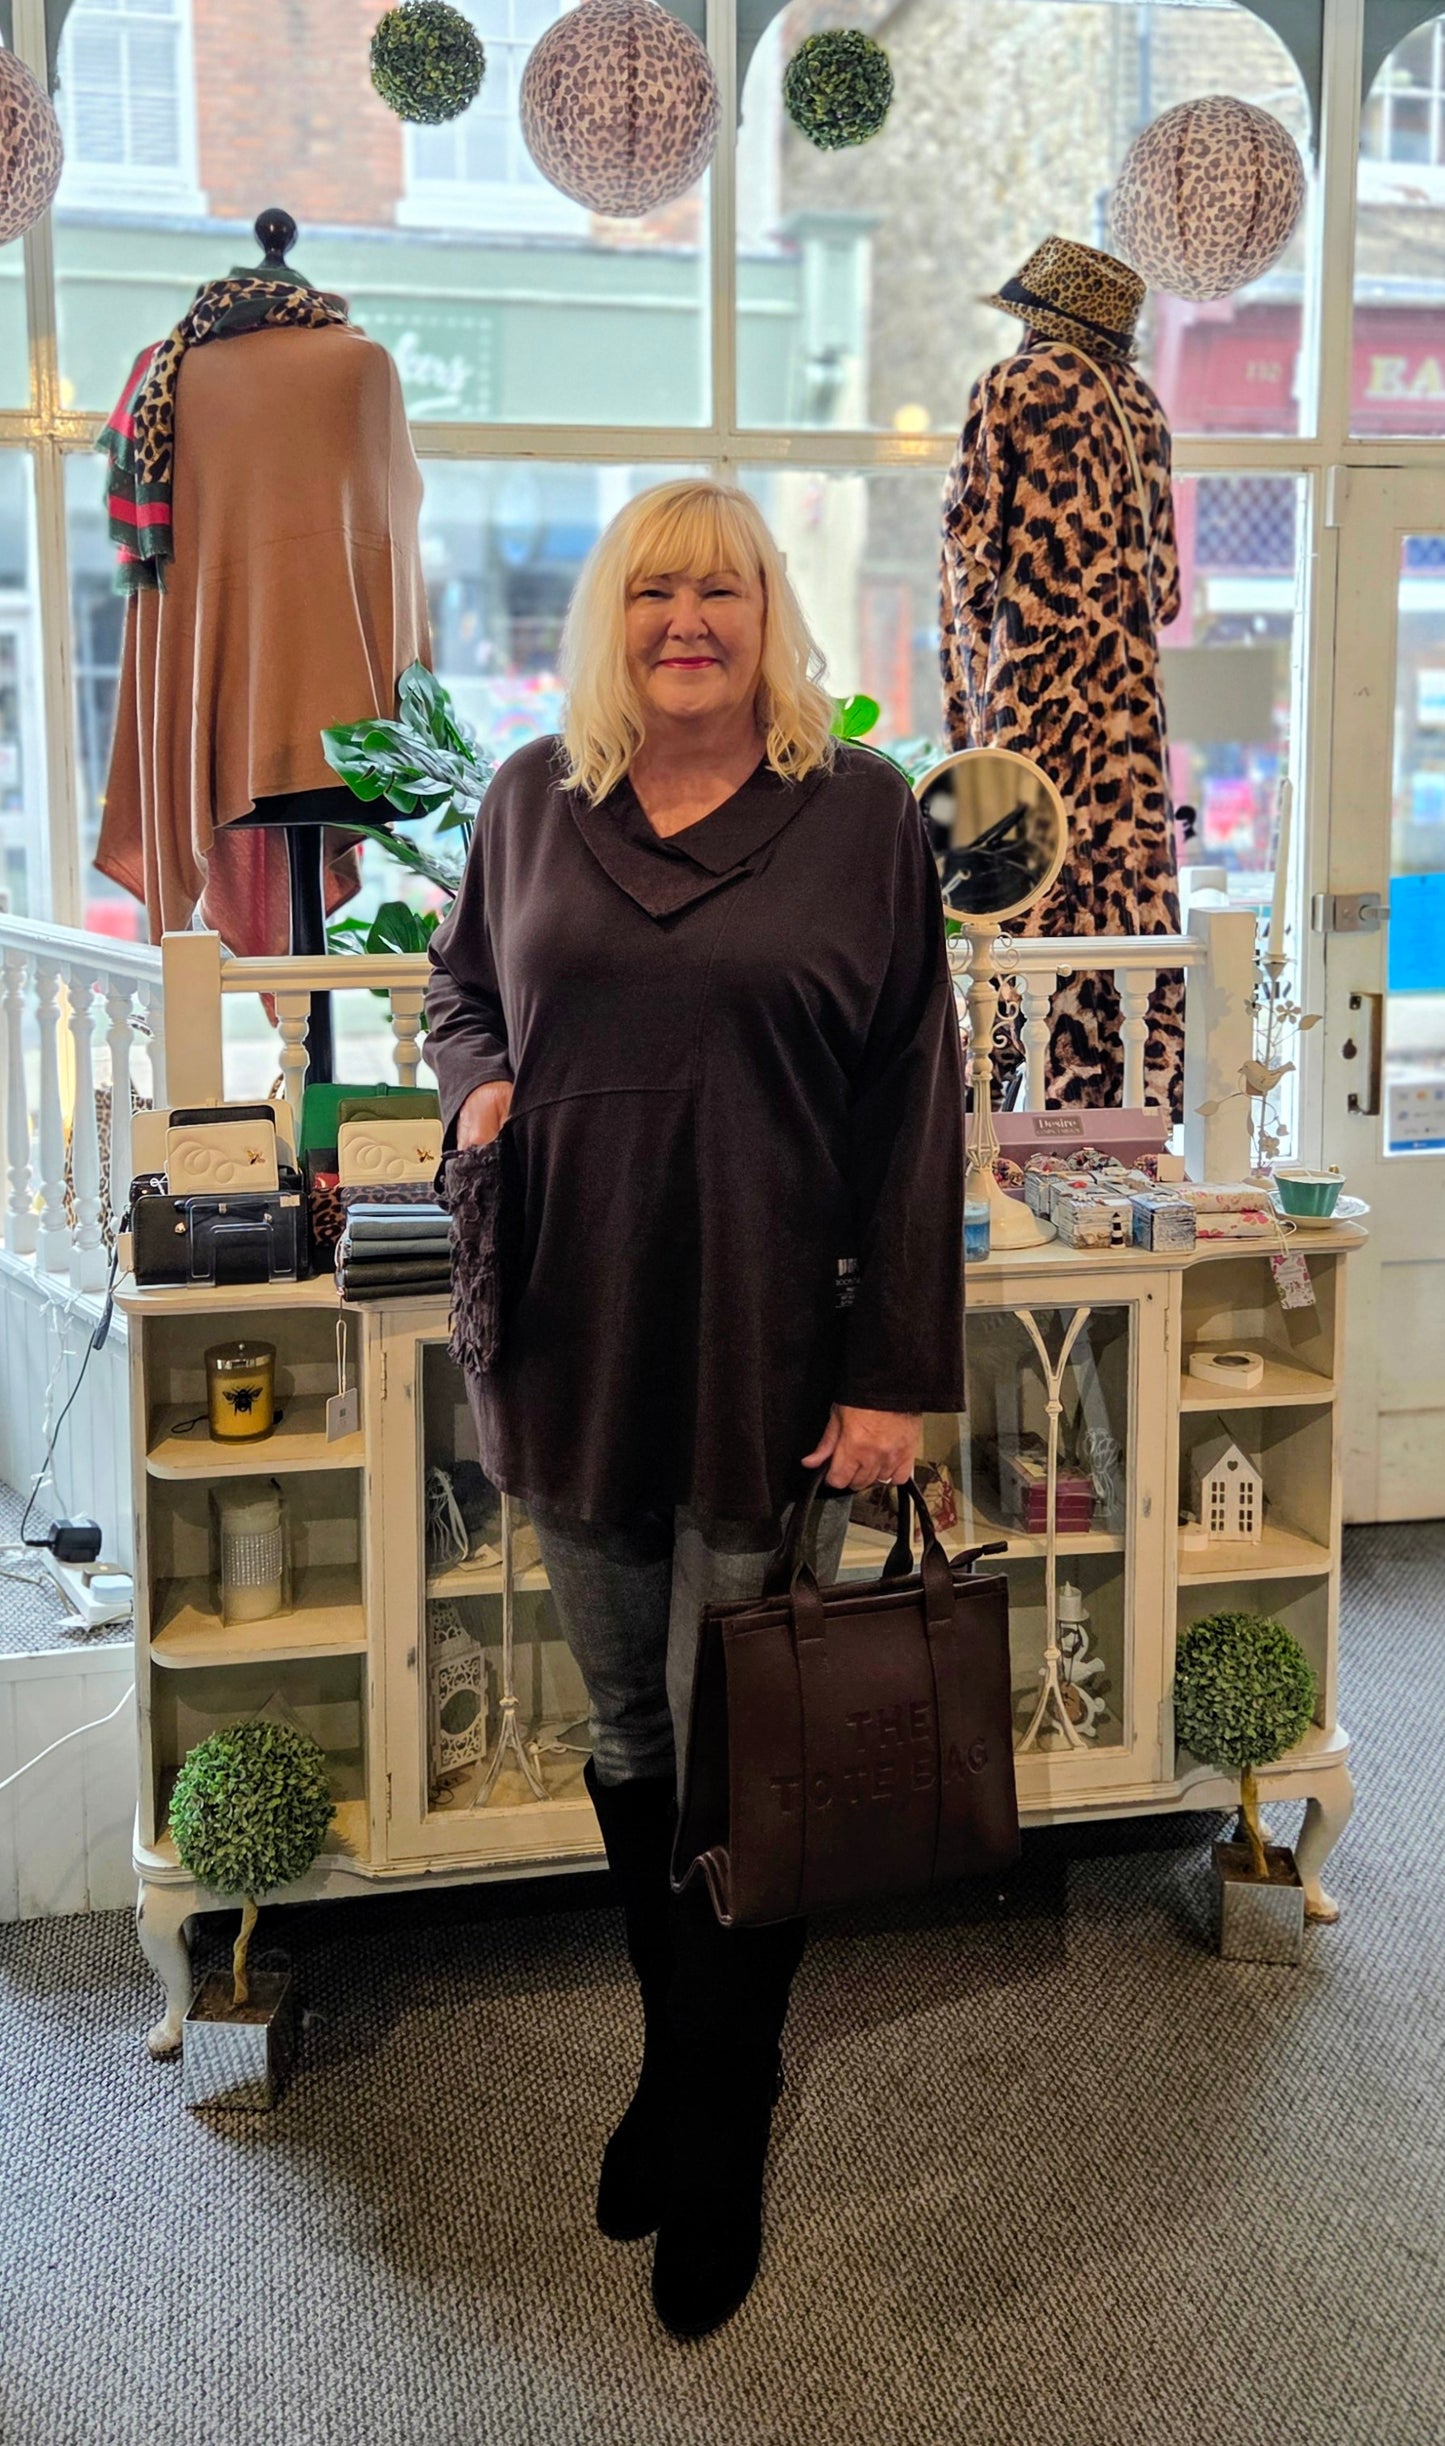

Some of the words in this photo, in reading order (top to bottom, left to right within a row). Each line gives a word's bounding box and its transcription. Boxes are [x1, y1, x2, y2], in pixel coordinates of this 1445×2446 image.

[1038, 1117, 1077, 1129] Desire
[845, 1701, 932, 1753] THE
[769, 1760, 894, 1816] TOTE
[910, 1736, 989, 1793] BAG
